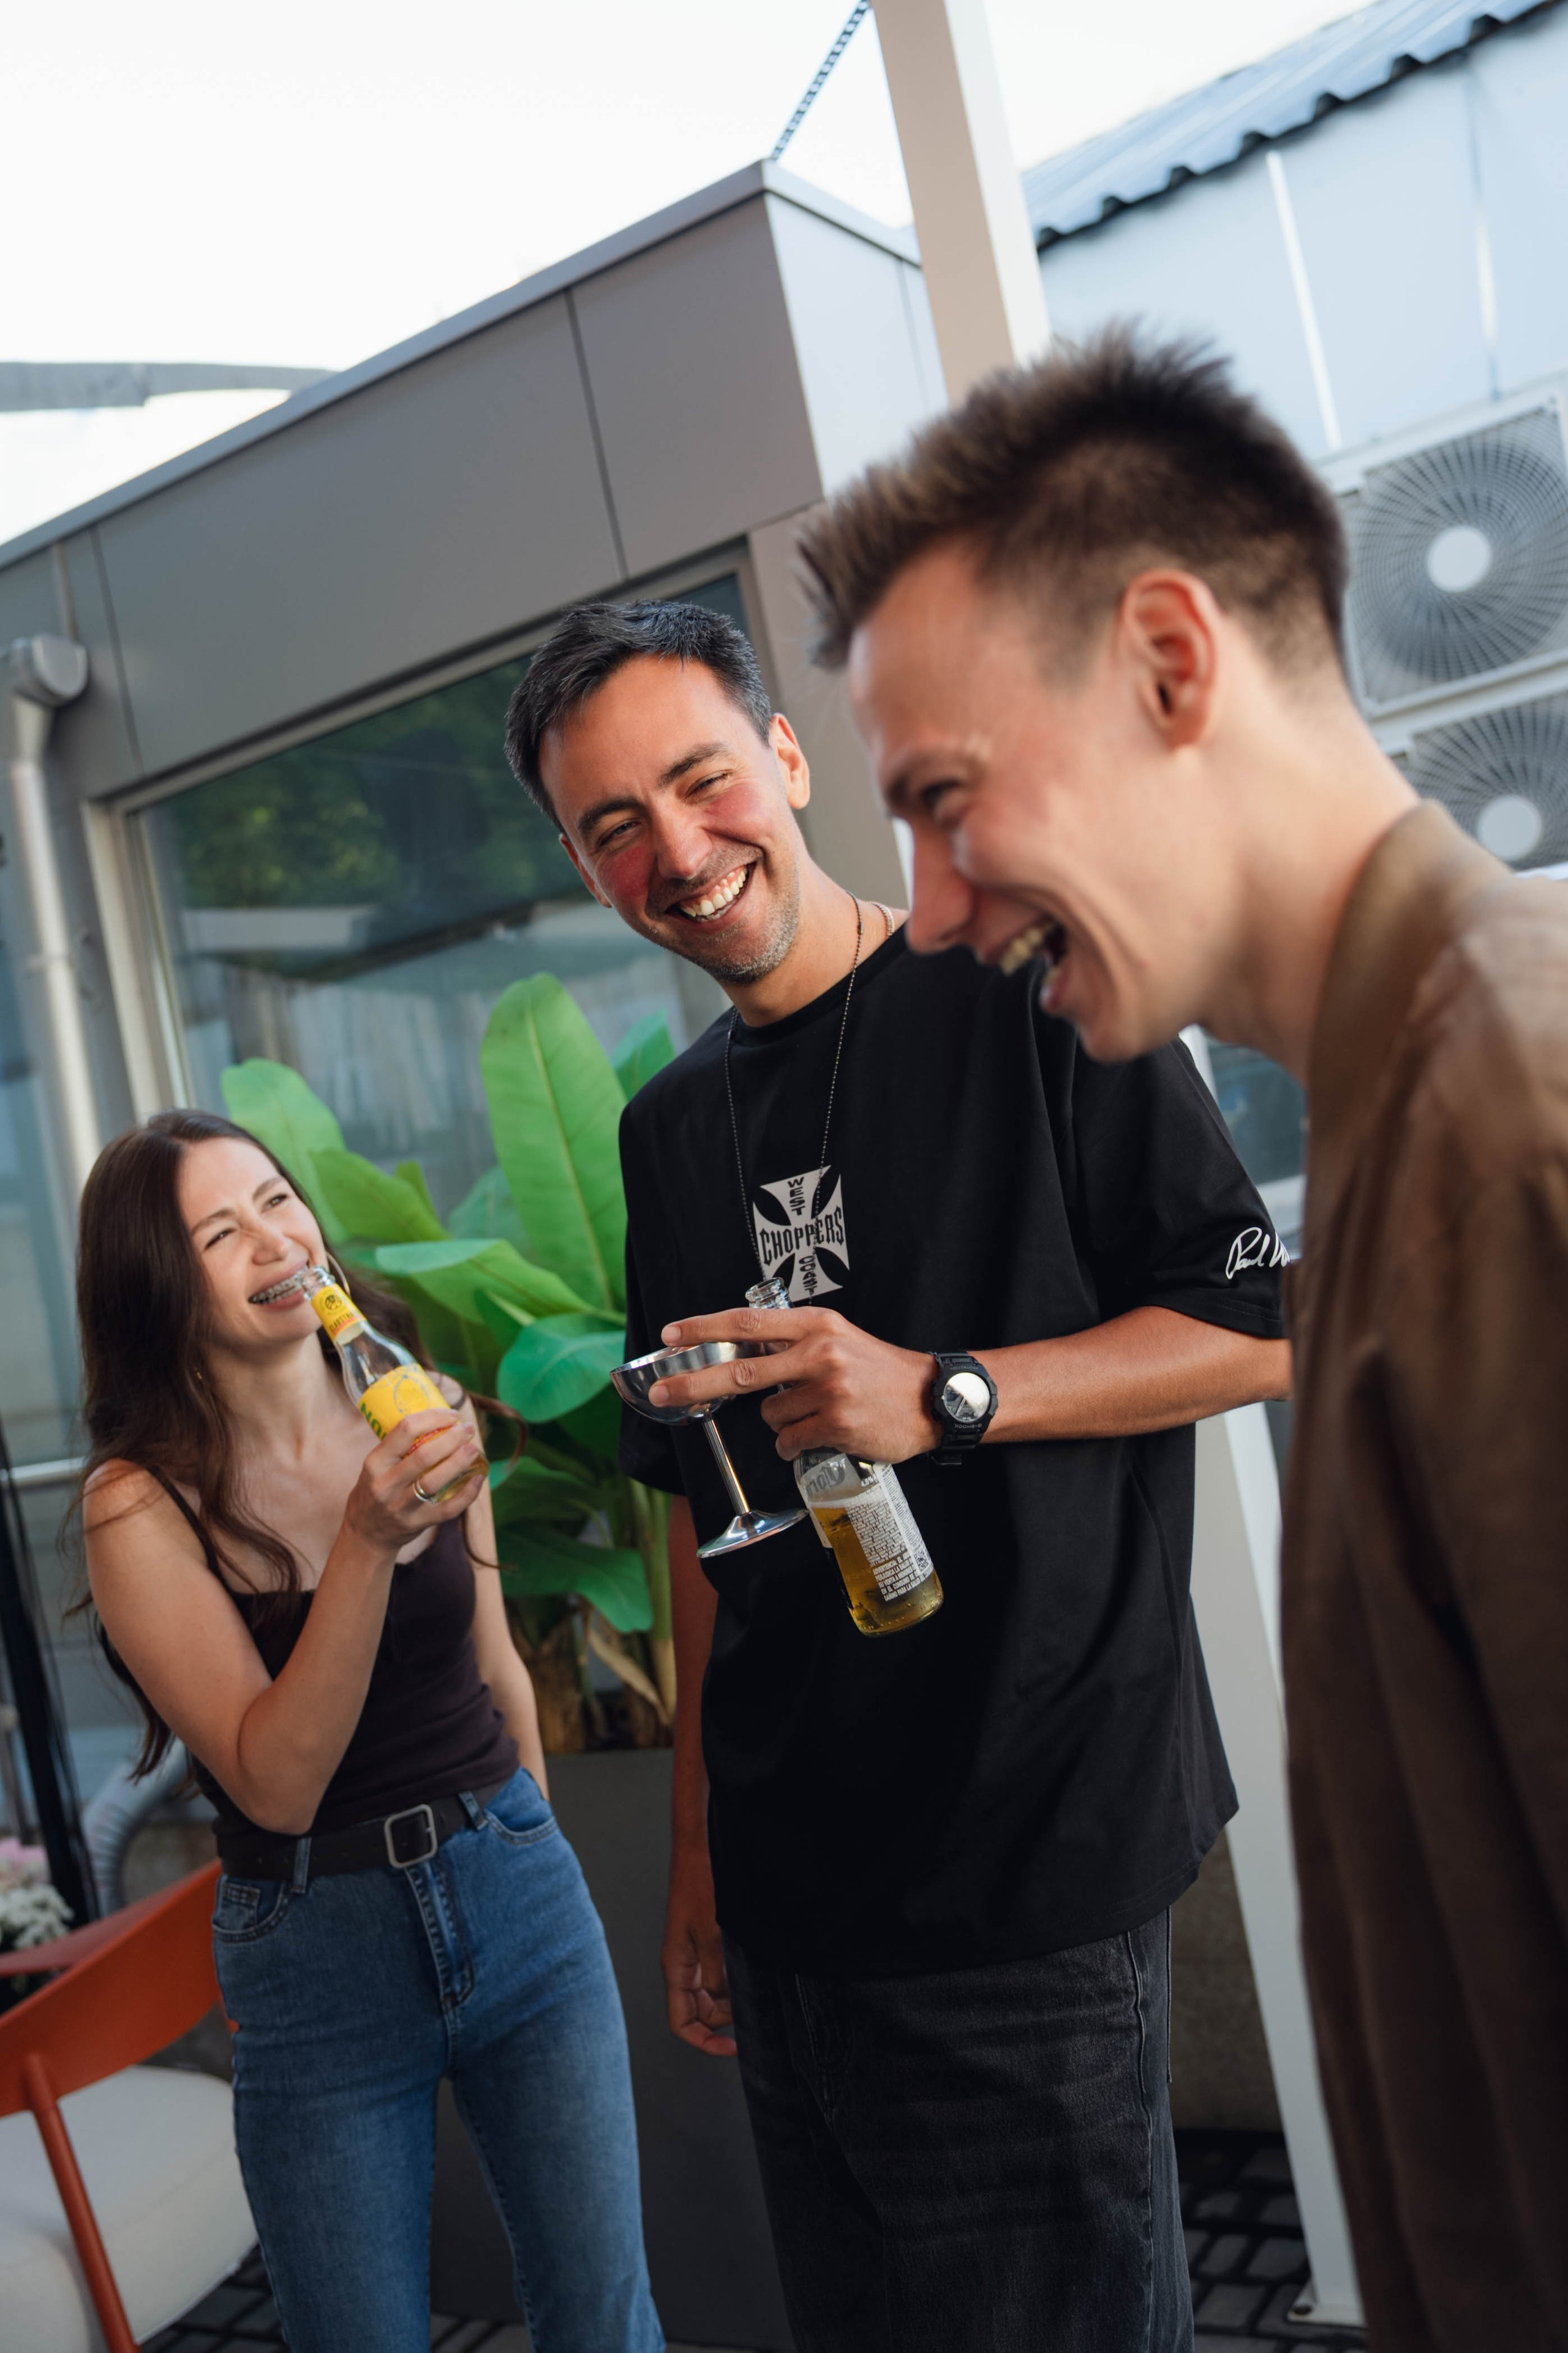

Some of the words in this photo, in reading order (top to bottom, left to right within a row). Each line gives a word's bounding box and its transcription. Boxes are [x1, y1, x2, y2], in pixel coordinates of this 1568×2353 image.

[788, 1176, 805, 1215] WEST
[759, 1206, 845, 1266] CHOPPERS
[799, 1256, 818, 1296] COAST
